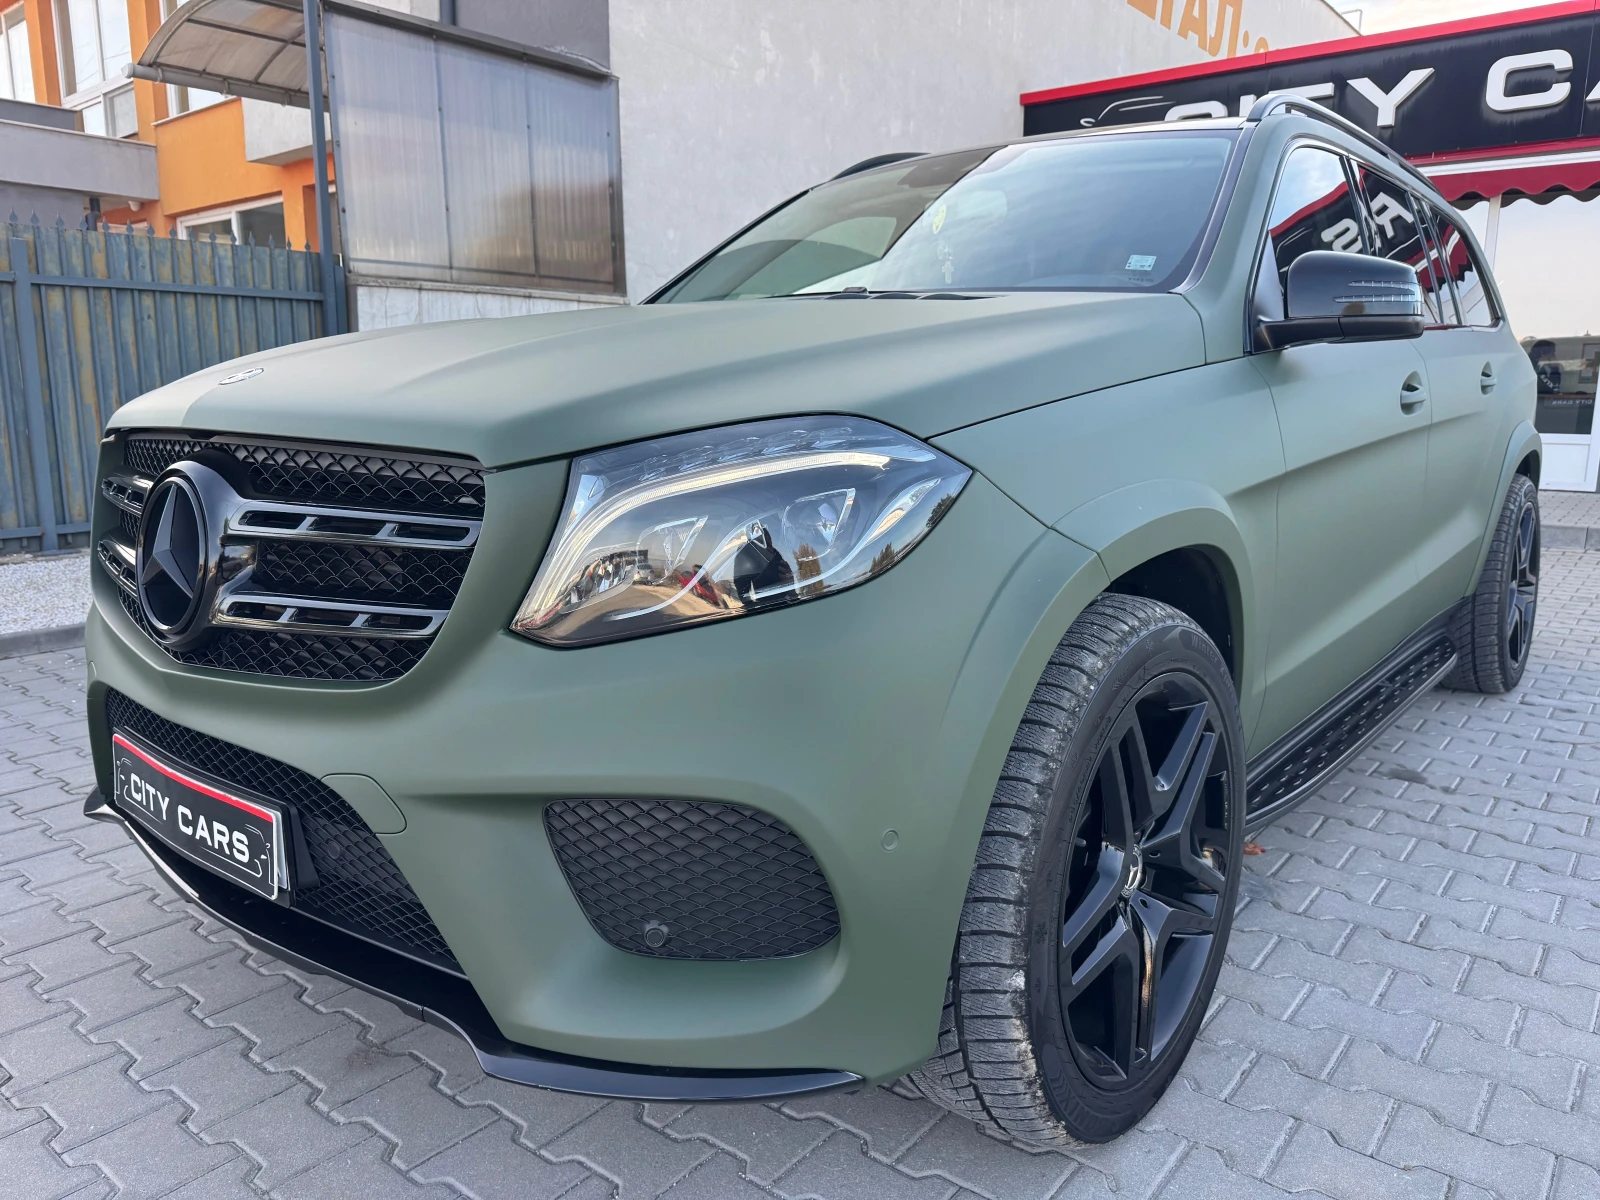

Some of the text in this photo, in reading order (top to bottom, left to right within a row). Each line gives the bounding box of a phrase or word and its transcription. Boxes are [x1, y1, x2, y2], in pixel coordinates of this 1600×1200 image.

[1486, 49, 1600, 112] C
[130, 773, 250, 863] CITY CARS
